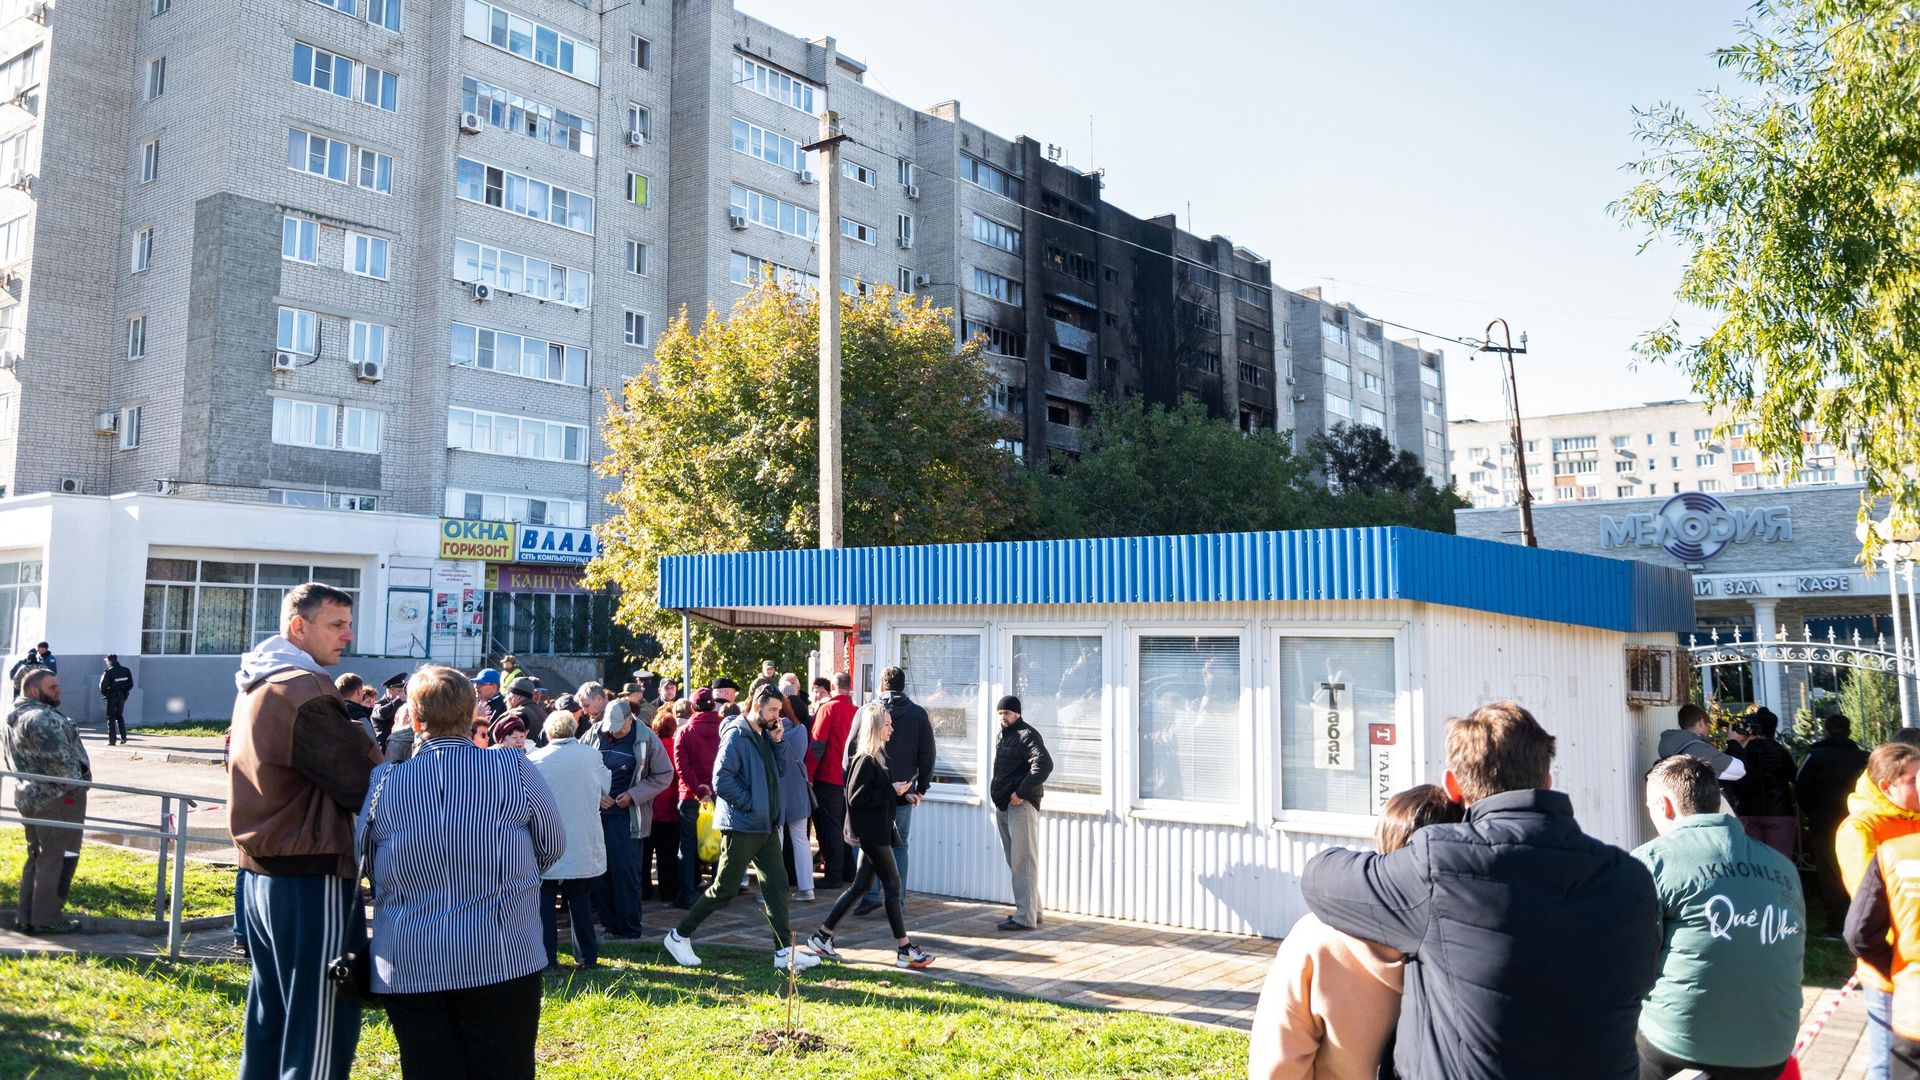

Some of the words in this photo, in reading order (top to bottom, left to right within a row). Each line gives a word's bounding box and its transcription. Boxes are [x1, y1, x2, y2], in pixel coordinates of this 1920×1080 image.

[443, 520, 509, 541] ОКНА
[1600, 506, 1792, 549] МЕЛОДИЯ
[442, 541, 509, 558] ГОРИЗОНТ
[521, 553, 536, 561] СЕТЬ
[537, 554, 590, 563] КОМПЬЮТЕРНЫХ
[1724, 580, 1763, 595] ЗАЛ
[1796, 576, 1849, 592] КАФЕ
[1320, 682, 1346, 766] Табак
[1705, 894, 1761, 941] Quê
